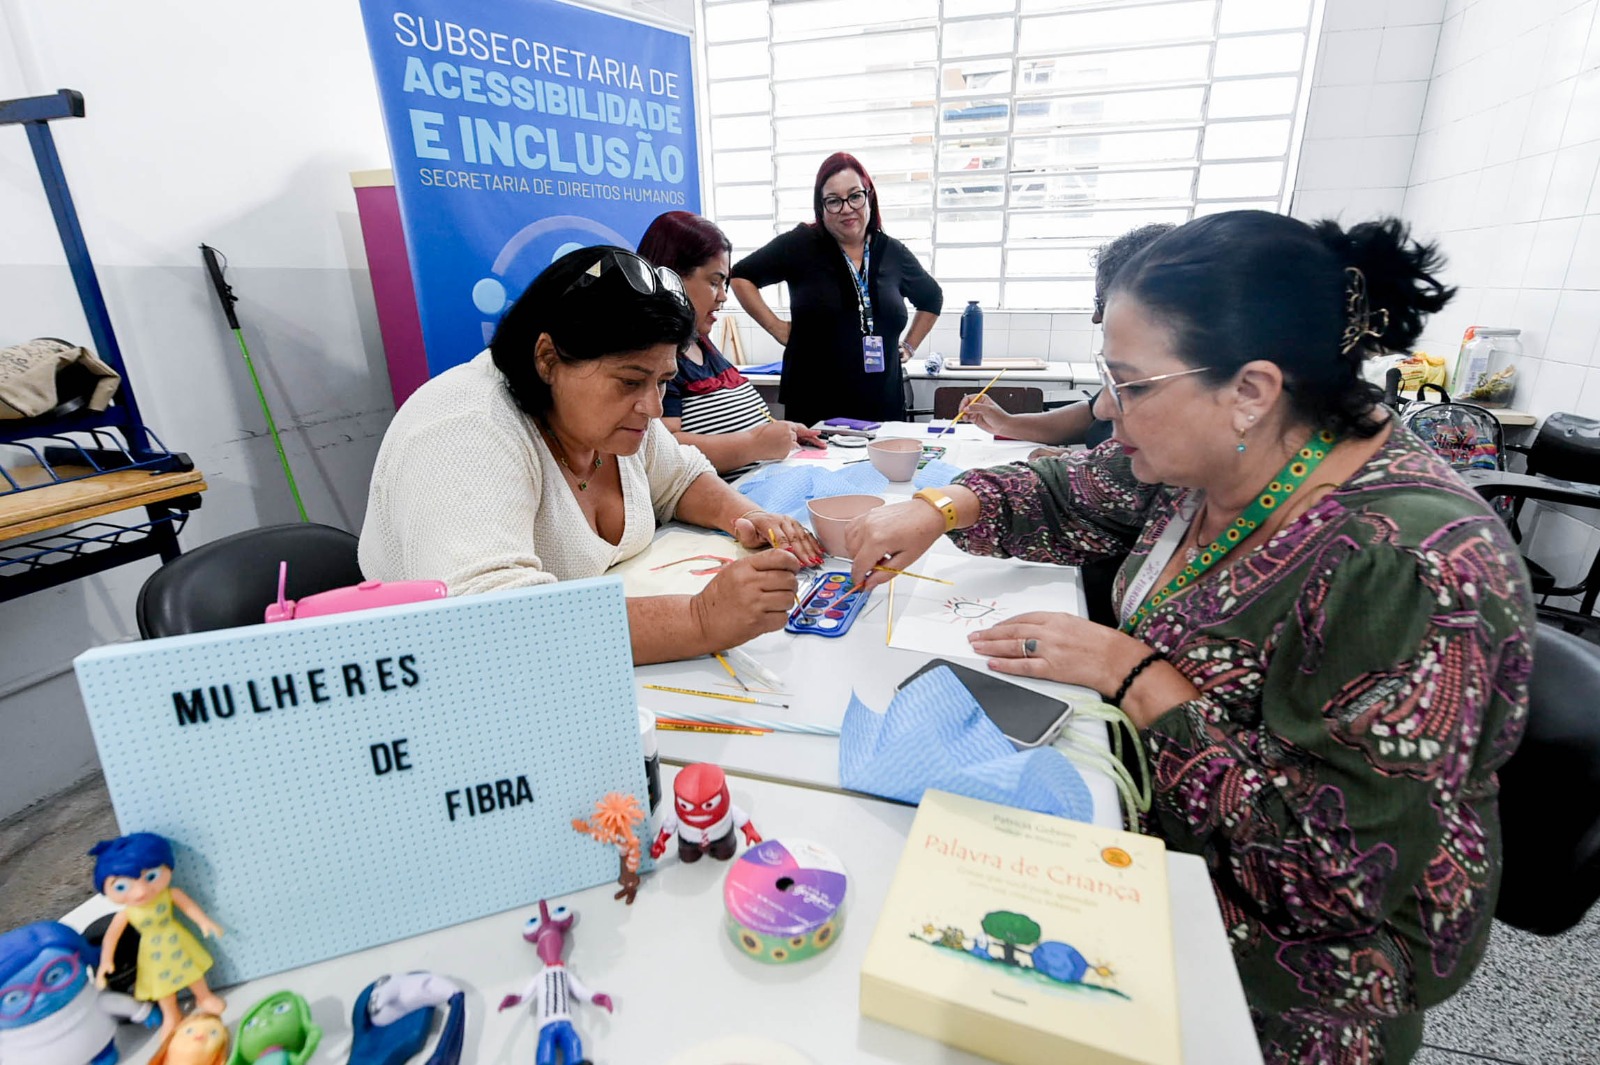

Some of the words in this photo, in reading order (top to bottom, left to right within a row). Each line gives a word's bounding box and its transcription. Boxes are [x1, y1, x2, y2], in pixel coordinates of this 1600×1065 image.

[392, 12, 645, 92] SUBSECRETARIA
[649, 69, 680, 99] DE
[403, 56, 683, 135] ACESSIBILIDADE
[409, 108, 450, 162] E
[458, 115, 685, 184] INCLUSÃO
[419, 168, 530, 193] SECRETARIA
[533, 178, 554, 196] DE
[557, 181, 621, 200] DIREITOS
[623, 189, 686, 206] HUMANOS
[171, 653, 421, 727] MULHERES
[369, 738, 413, 776] DE
[444, 775, 535, 822] FIBRA
[924, 834, 1003, 870] Palavra
[1010, 857, 1040, 878] de
[1046, 865, 1141, 904] Criança
